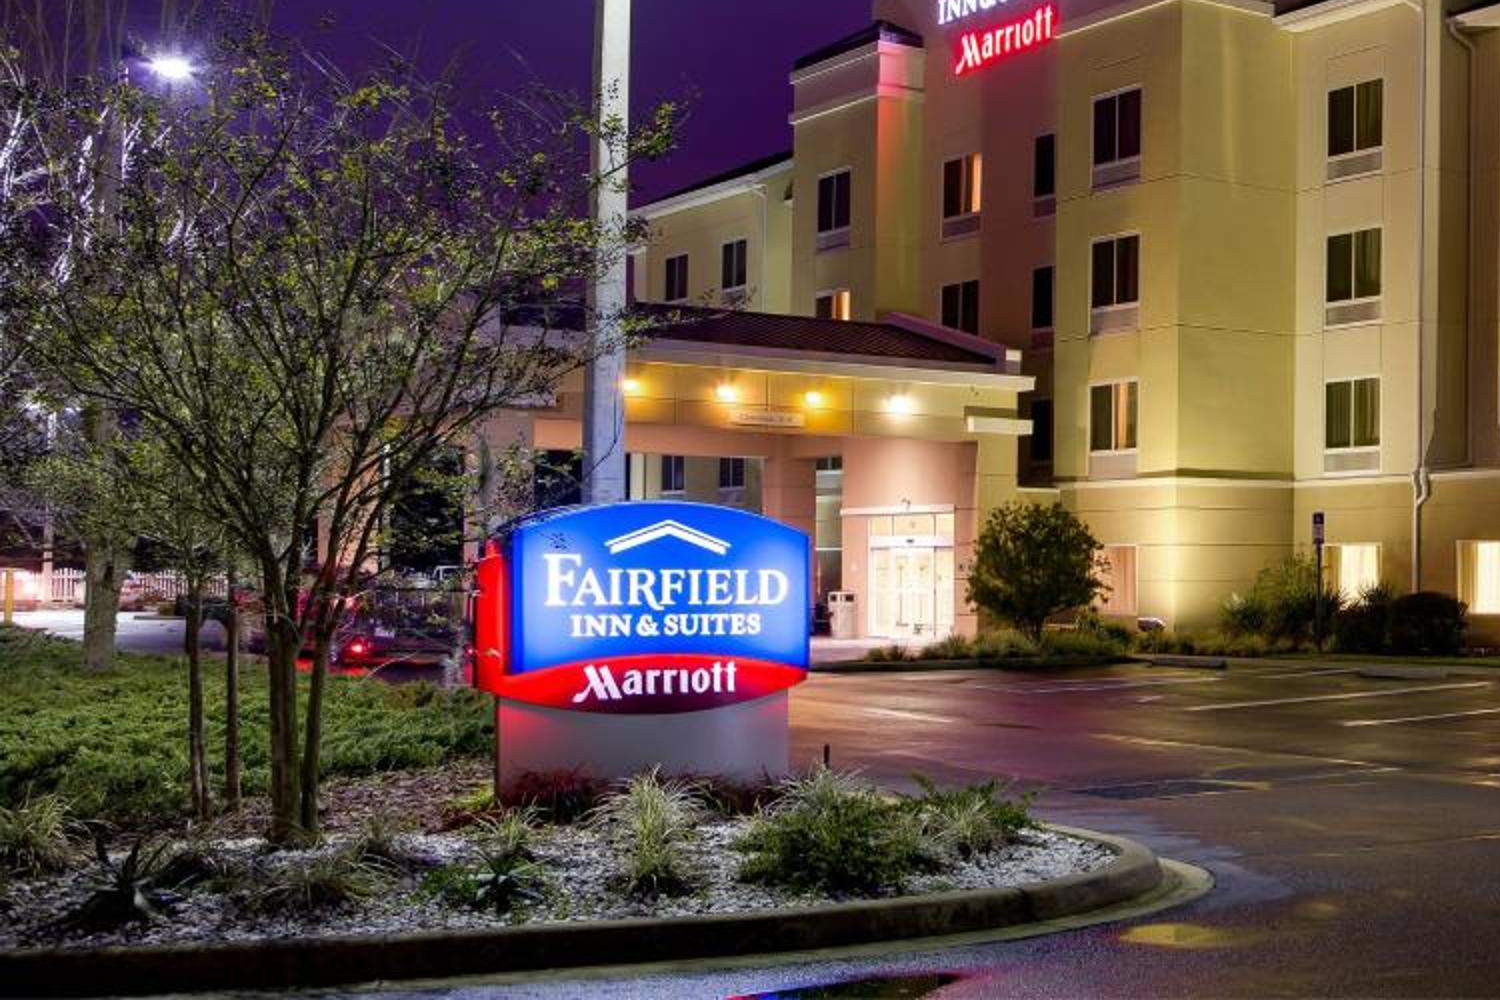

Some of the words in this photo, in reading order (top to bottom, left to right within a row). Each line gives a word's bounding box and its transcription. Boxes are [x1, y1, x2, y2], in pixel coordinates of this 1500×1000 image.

[955, 5, 1053, 75] Marriott
[543, 553, 789, 610] FAIRFIELD
[571, 614, 632, 637] INN
[637, 613, 661, 637] &
[664, 613, 762, 636] SUITES
[573, 662, 737, 703] Marriott
